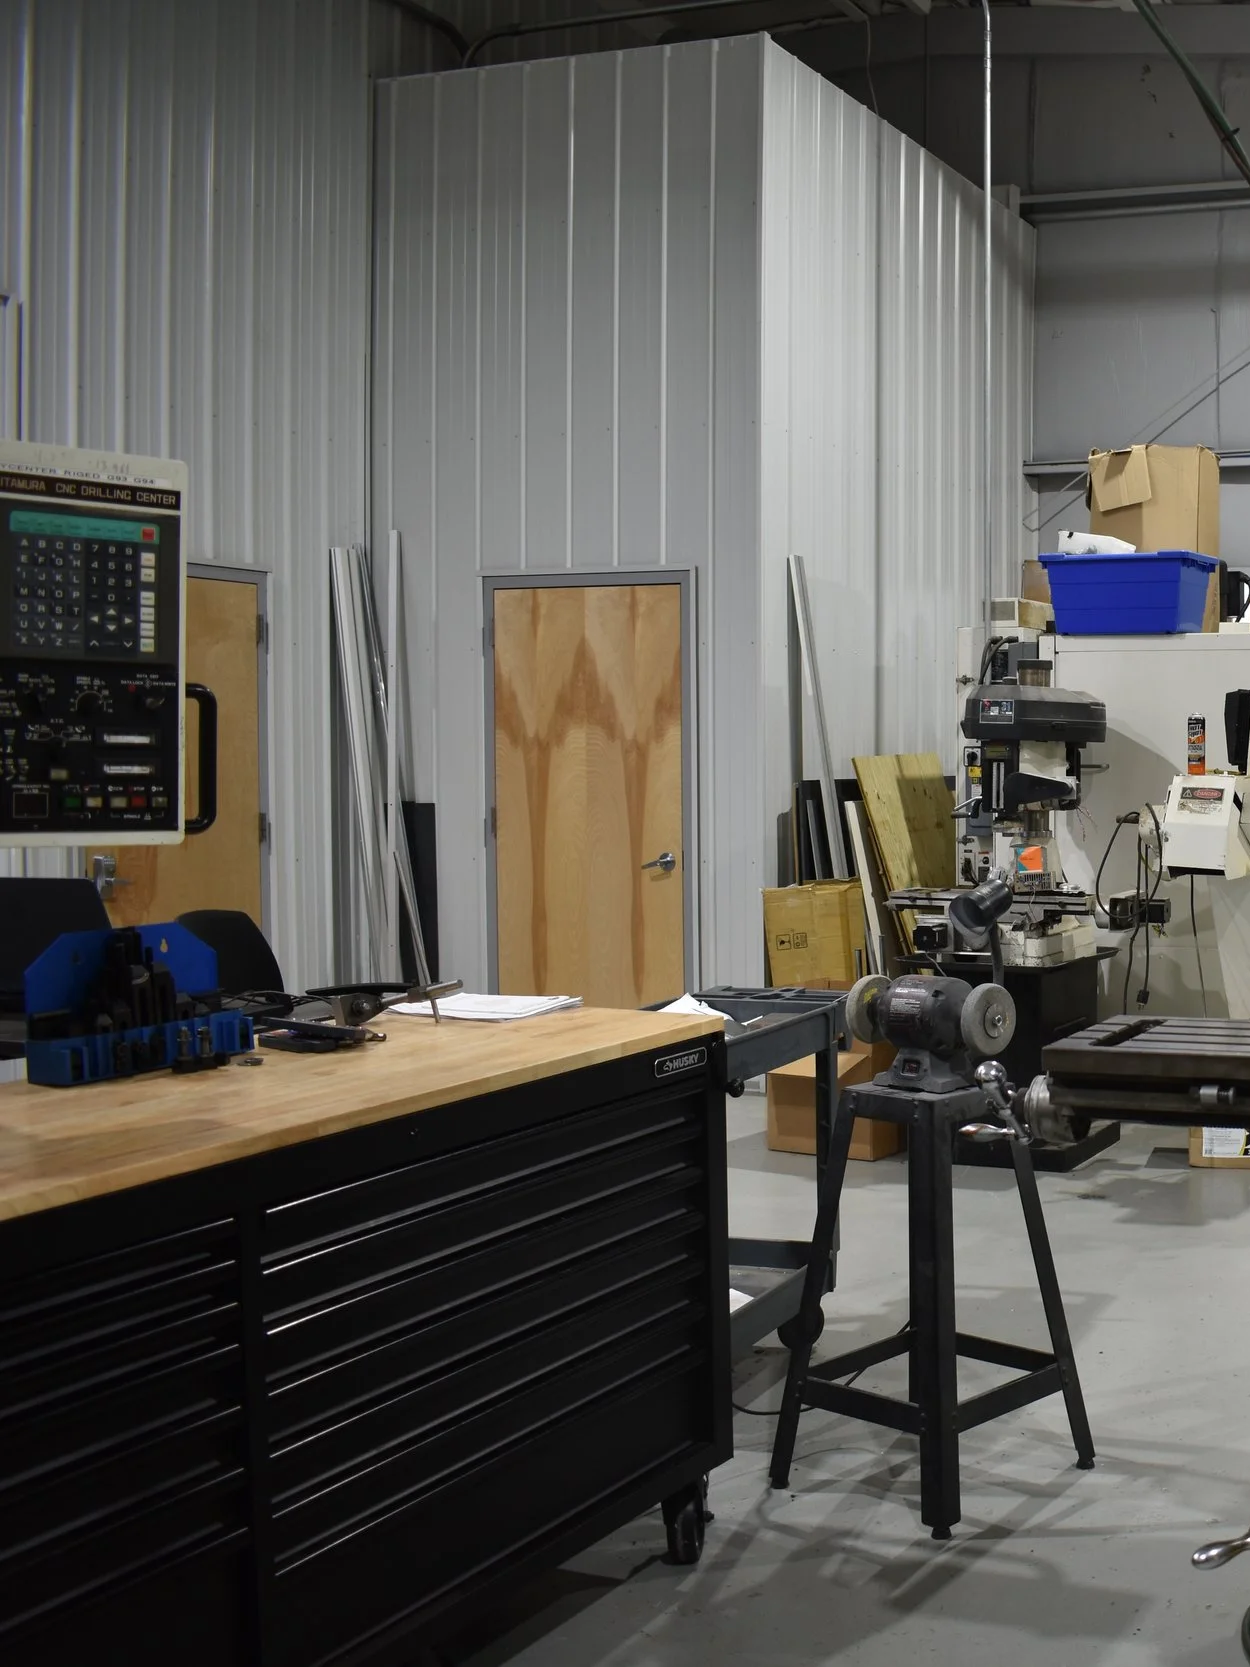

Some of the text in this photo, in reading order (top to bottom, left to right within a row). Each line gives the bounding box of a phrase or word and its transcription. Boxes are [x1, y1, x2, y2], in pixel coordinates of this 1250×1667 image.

[107, 475, 129, 483] G93
[134, 478, 157, 486] G94
[56, 482, 77, 496] CNC
[81, 485, 132, 501] DRILLING
[136, 491, 176, 506] CENTER
[673, 1053, 699, 1069] HUSKY
